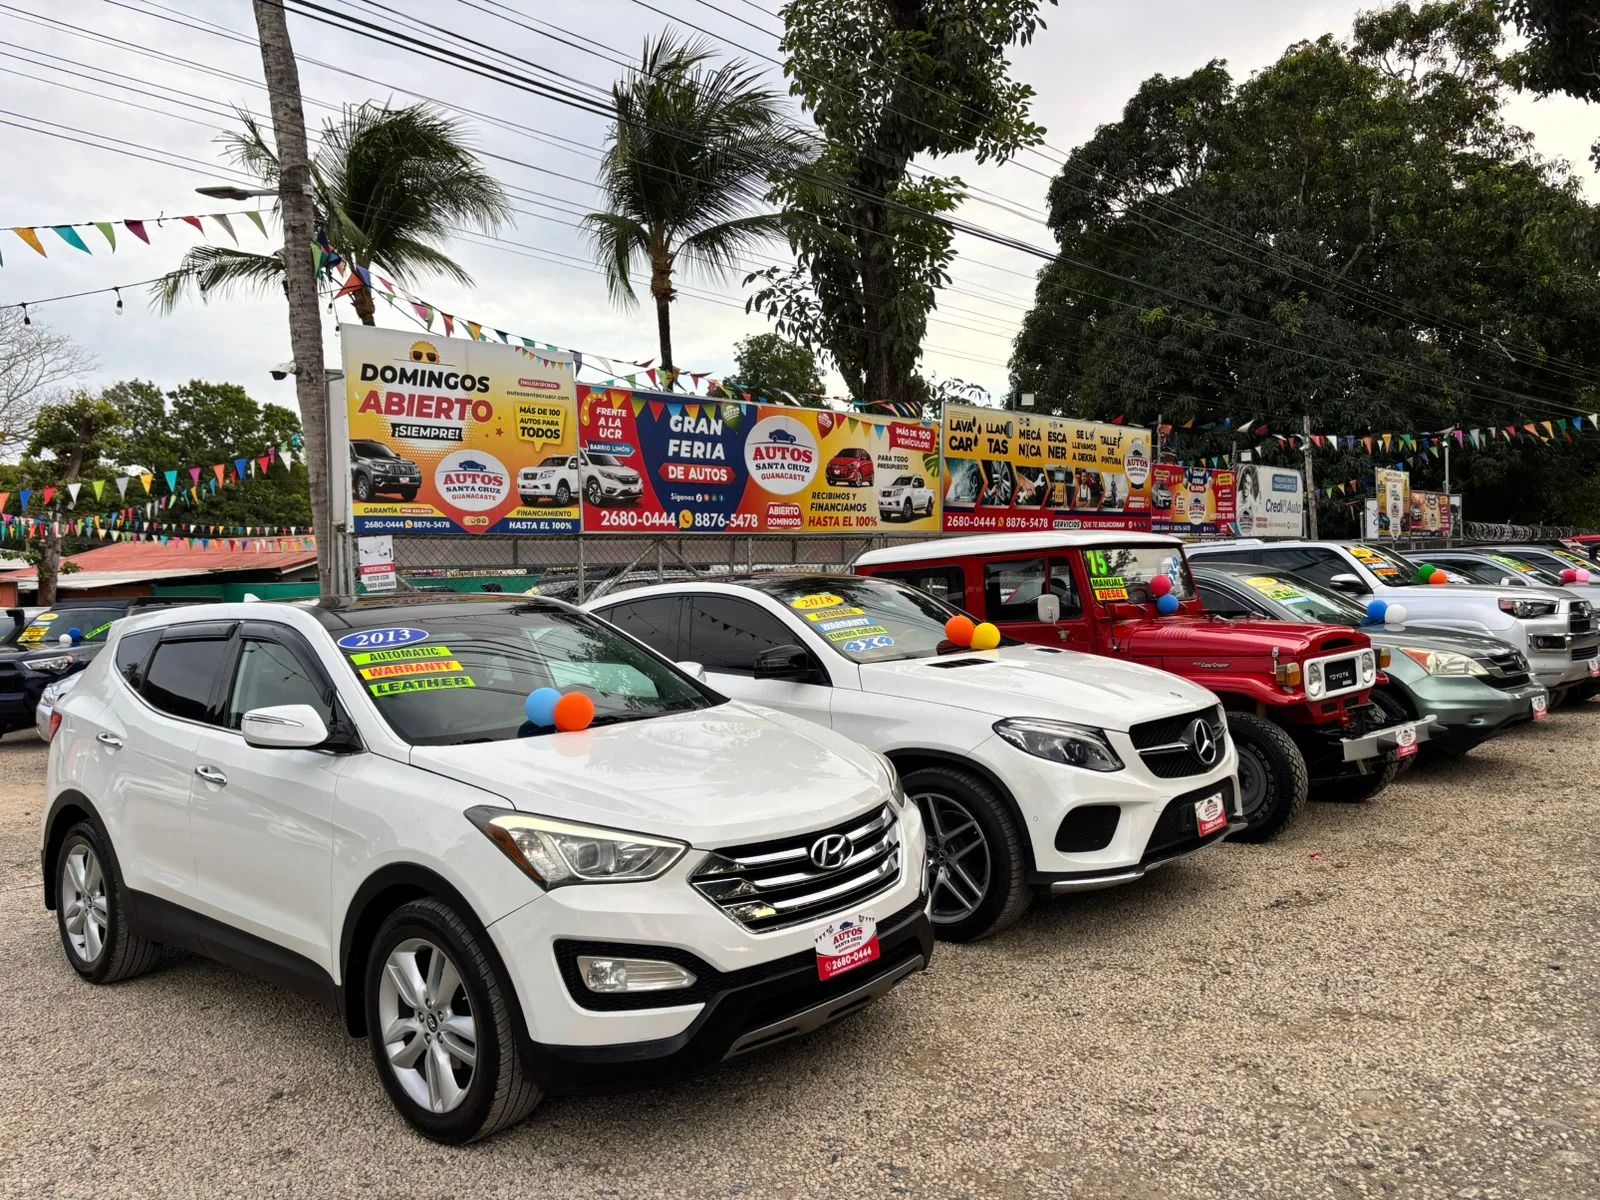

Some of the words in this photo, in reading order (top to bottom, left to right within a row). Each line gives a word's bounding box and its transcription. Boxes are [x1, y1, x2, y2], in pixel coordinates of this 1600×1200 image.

[361, 363, 490, 393] DOMINGOS
[358, 390, 493, 423] ABIERTO
[520, 405, 536, 414] MÁS
[596, 407, 627, 417] FRENTE
[598, 417, 606, 426] A
[608, 418, 622, 428] LA
[669, 415, 723, 436] GRAN
[950, 419, 973, 433] LAVA
[395, 426, 459, 439] ¡SIEMPRE!
[520, 426, 561, 439] TODOS
[599, 428, 623, 440] UCR
[919, 431, 931, 440] 100
[1019, 428, 1041, 441] MECÁ
[1047, 431, 1067, 443] ESCA
[1076, 430, 1084, 439] SE
[590, 444, 611, 452] BARRIO
[612, 445, 630, 453] LIMÓN
[949, 436, 973, 452] CAR
[987, 438, 1008, 455] TAS
[1072, 442, 1097, 451] LLEVAMOS
[668, 439, 726, 461] FERIA
[753, 446, 813, 464] AUTOS
[1048, 446, 1067, 460] NER
[1107, 448, 1115, 456] DE
[1072, 453, 1077, 461] A
[1078, 453, 1097, 463] DEKRA
[1101, 456, 1122, 465] PINTURA
[1127, 458, 1148, 468] AUTOS
[668, 465, 686, 480] DE
[688, 467, 728, 482] AUTOS
[755, 463, 785, 471] SANTA
[787, 463, 811, 473] CRUZ
[443, 473, 504, 487] AUTOS
[761, 473, 806, 482] GUANACASTE
[446, 485, 476, 493] SANTA
[478, 486, 502, 494] CRUZ
[452, 493, 497, 501] GUANACASTE
[811, 492, 850, 500] RECIBIMOS
[363, 506, 398, 514] GARANTÍA
[769, 506, 800, 516] ABIERTO
[810, 502, 867, 512] FINANCIAMOS
[516, 509, 572, 518] FINANCIAMIENTO
[600, 510, 677, 527] 2680-0444
[694, 513, 758, 528] 8876-5478
[364, 521, 404, 529] 2680-0444
[413, 521, 450, 529] 8876-5478
[509, 521, 538, 530] HASTA
[540, 522, 550, 530] EL
[552, 522, 573, 530] 100%
[767, 518, 801, 526] DOMINGOS
[808, 516, 840, 527] HASTA
[842, 516, 853, 526] EL
[855, 516, 878, 527] 100%
[947, 516, 996, 527] 2680-0444
[1006, 517, 1048, 528] 8876-5478
[1054, 520, 1080, 528] SERVICIOS
[1092, 578, 1123, 587] MANUAL
[1099, 589, 1126, 599] DIESEL
[801, 596, 834, 608] 2018
[815, 608, 858, 619] AUTOMATIC
[821, 618, 871, 630] WARRANTY
[356, 629, 412, 647] 2013
[828, 629, 857, 640] TURBO
[857, 626, 885, 636] DIESEL
[370, 648, 438, 661] AUTOMATIC
[368, 661, 453, 678] WARRANTY
[1329, 671, 1350, 681] TOYOTA
[378, 678, 466, 693] LEATHER
[833, 927, 863, 944] AUTOS
[832, 947, 872, 970] 2680-0444
